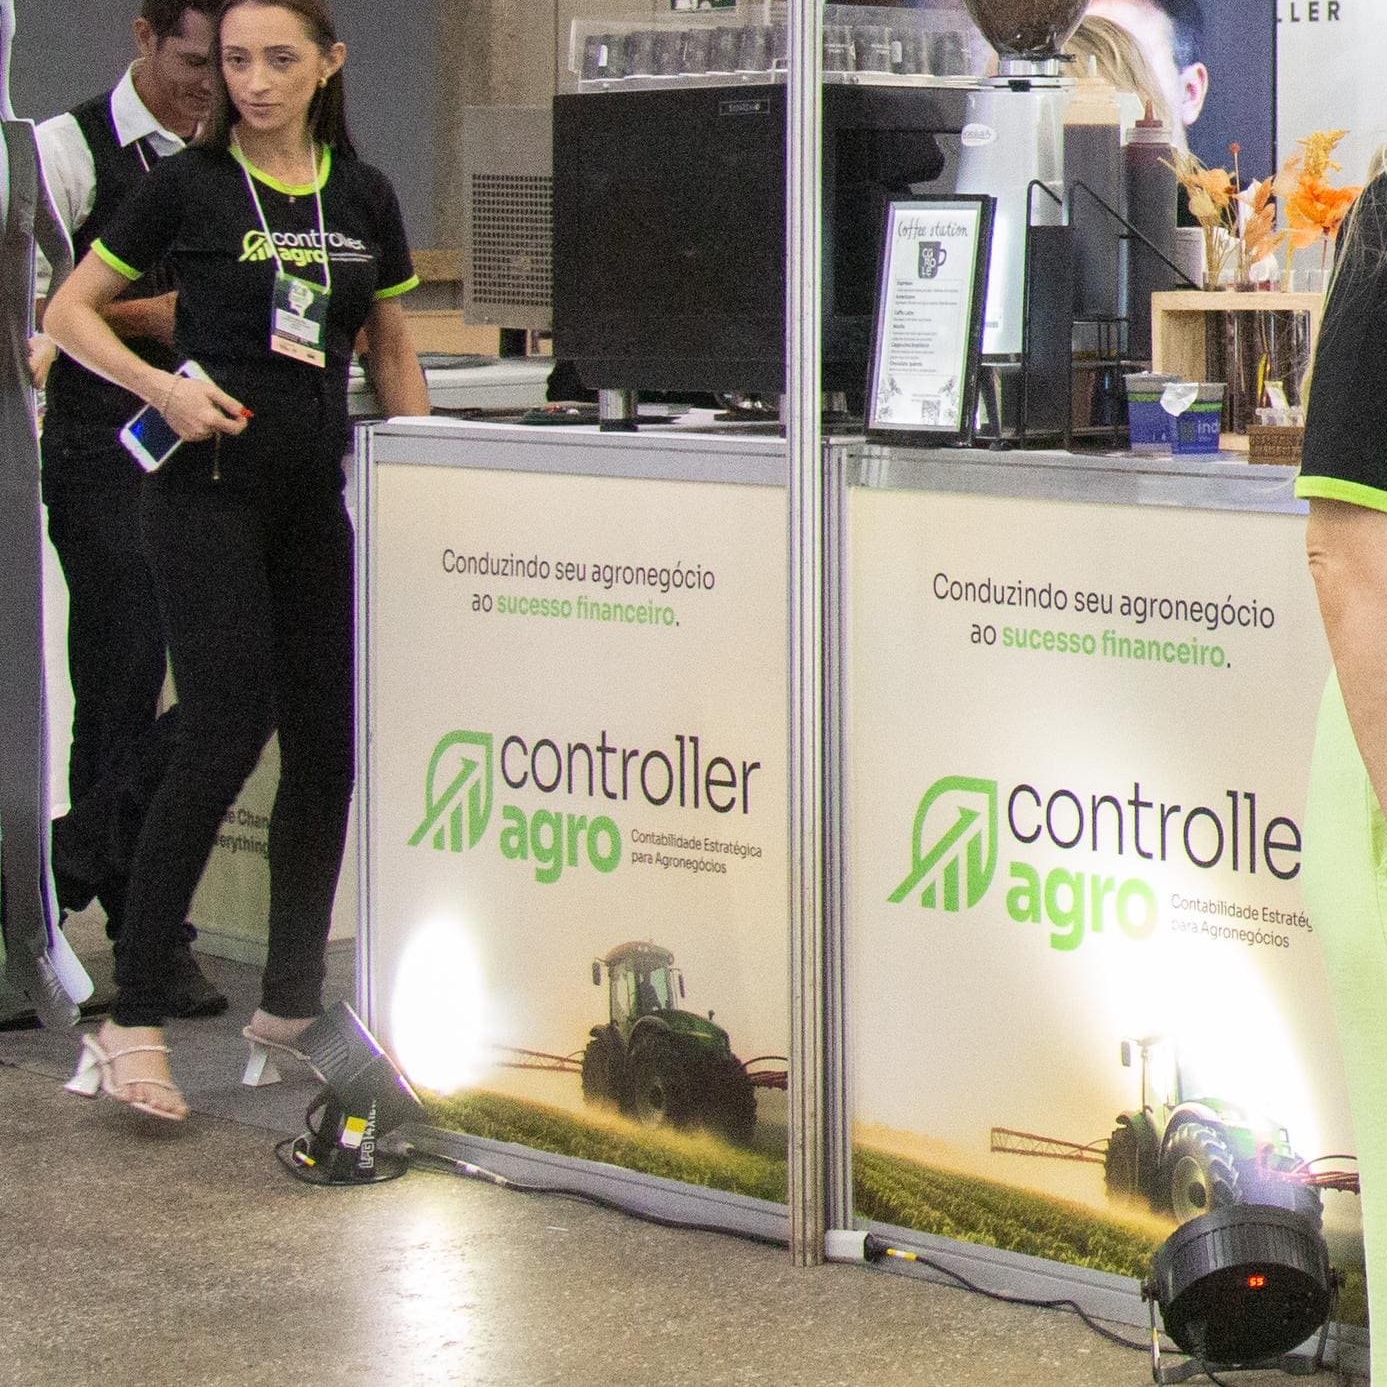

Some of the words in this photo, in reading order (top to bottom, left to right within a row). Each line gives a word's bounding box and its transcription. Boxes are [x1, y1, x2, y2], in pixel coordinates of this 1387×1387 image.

[898, 217, 926, 240] Coffee
[929, 221, 968, 237] station
[442, 549, 550, 580] Conduzindo
[555, 562, 586, 583] seu
[591, 560, 715, 593] agronegócio
[472, 591, 493, 612] ao
[497, 594, 572, 619] sucesso
[576, 595, 681, 627] financeiro.
[933, 573, 1068, 611] Conduzindo
[1073, 593, 1113, 614] seu
[1120, 593, 1275, 630] agronegócio
[970, 621, 997, 646] ao
[1002, 623, 1096, 655] sucesso
[1101, 629, 1232, 669] financeiro.
[500, 730, 761, 815] controller
[500, 804, 622, 884] agro
[631, 828, 702, 852] Contabilidade
[704, 836, 763, 859] Estratégica
[1008, 781, 1302, 880] controlle
[631, 850, 653, 867] para
[655, 851, 727, 875] Agronegócios
[1005, 858, 1157, 952] agro
[1170, 893, 1259, 921] Contabilidade
[1262, 907, 1314, 932] Estraté
[1171, 919, 1198, 934] para
[1201, 920, 1290, 949] Agronegócios
